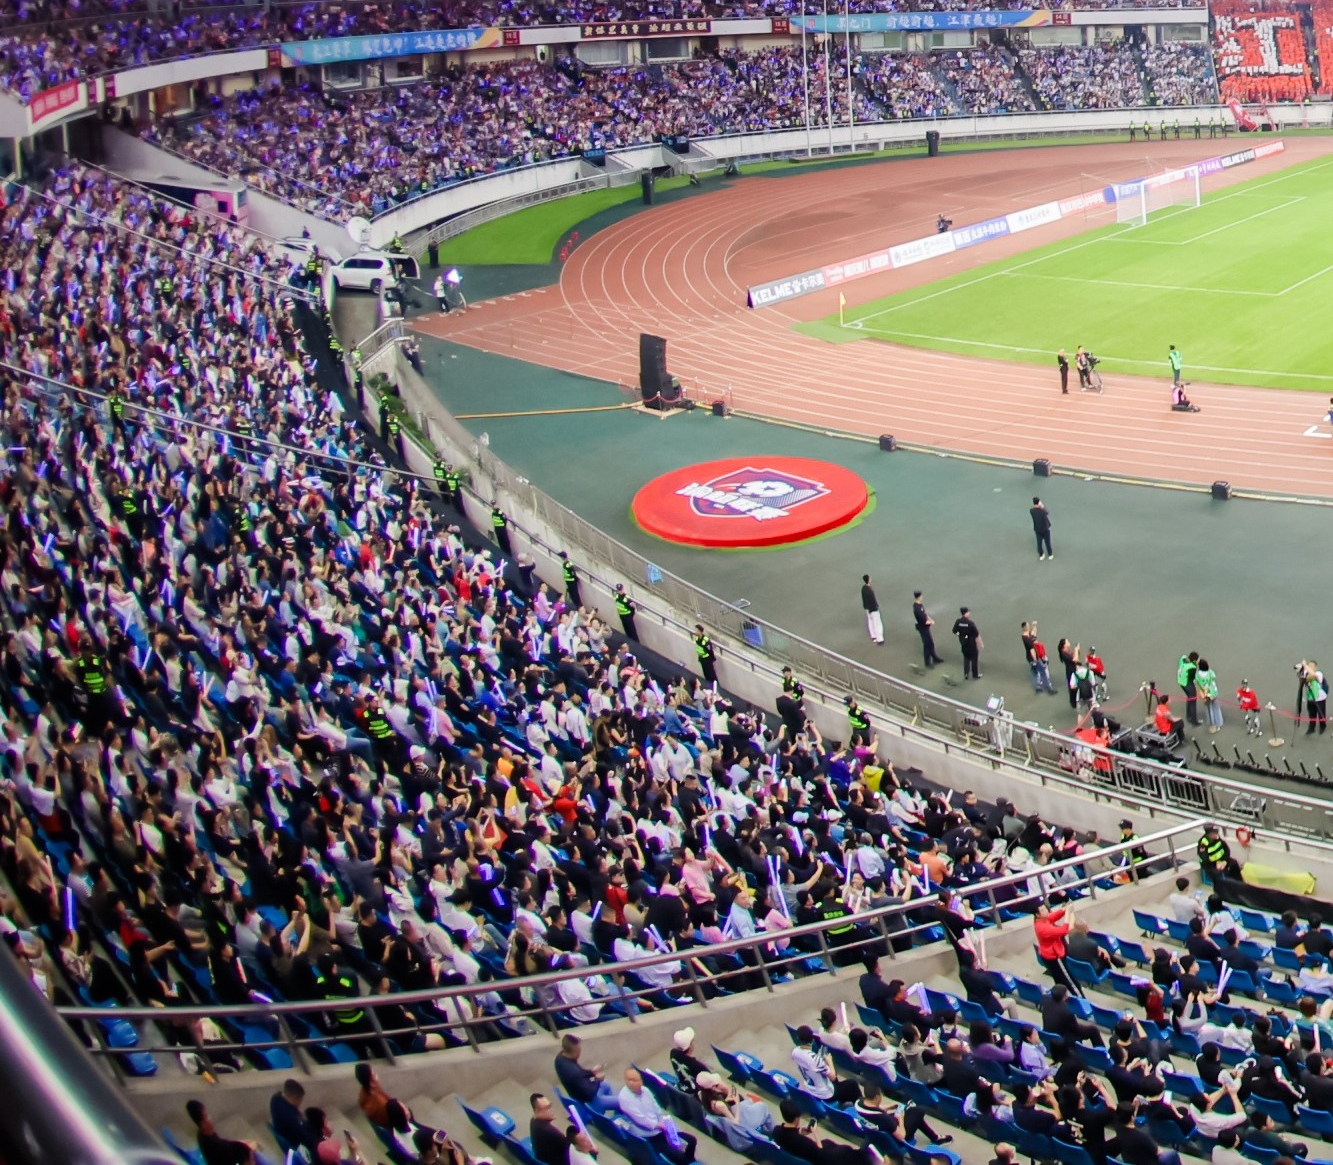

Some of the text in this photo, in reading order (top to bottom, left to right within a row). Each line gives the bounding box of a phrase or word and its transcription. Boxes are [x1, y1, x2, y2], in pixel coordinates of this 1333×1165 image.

[801, 271, 826, 291] 卡尔美
[751, 281, 793, 305] KELME
